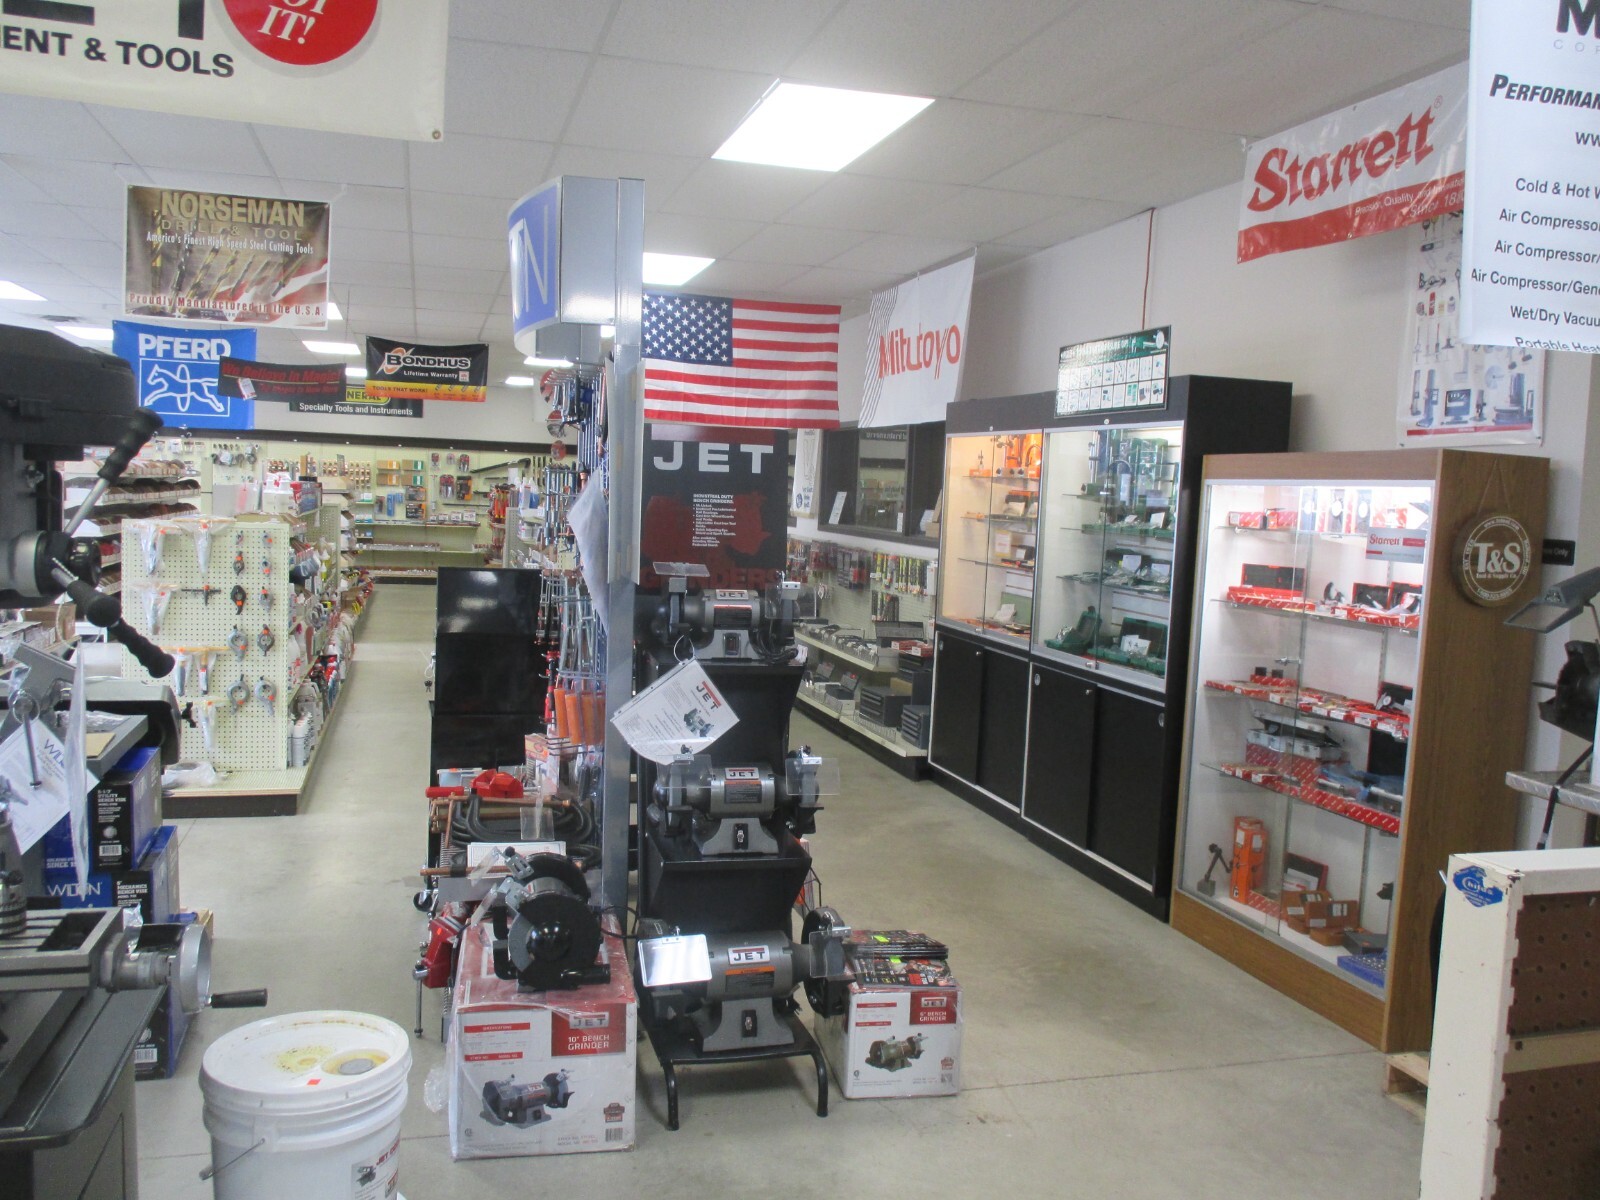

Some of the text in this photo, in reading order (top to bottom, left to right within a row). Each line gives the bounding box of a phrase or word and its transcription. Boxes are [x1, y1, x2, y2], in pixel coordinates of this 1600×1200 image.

[257, 5, 316, 45] IT!
[84, 37, 107, 62] &
[115, 40, 235, 78] TOOLS
[1247, 105, 1436, 212] Starrett
[1515, 177, 1548, 194] Cold
[1551, 181, 1561, 195] &
[1566, 183, 1590, 199] Hot
[161, 191, 305, 227] NORSEMAN
[1384, 192, 1415, 207] Quality
[1499, 208, 1517, 223] Air
[161, 219, 303, 241] DRILL & TOOL
[146, 231, 314, 255] America's Finest High Speed Steel Cutting Tools
[1494, 240, 1512, 254] Air
[1471, 268, 1487, 282] Air
[129, 293, 324, 316] Proudly Manufactured in the U.S.A.
[1510, 305, 1560, 325] Wet/Dry
[138, 333, 231, 360] PFERD
[878, 322, 961, 380] Mitutoyo
[386, 354, 471, 368] BONDHUS
[404, 370, 429, 378] Lifetime
[430, 371, 458, 380] Warranty
[299, 402, 413, 416] Specialty Tools and Instruments
[653, 441, 774, 474] JET
[1473, 542, 1521, 574] T&S
[695, 684, 719, 710] JET
[733, 951, 765, 962] JET
[573, 1018, 609, 1027] JET
[568, 1041, 610, 1050] GRINDER
[582, 1034, 610, 1042] BENCH
